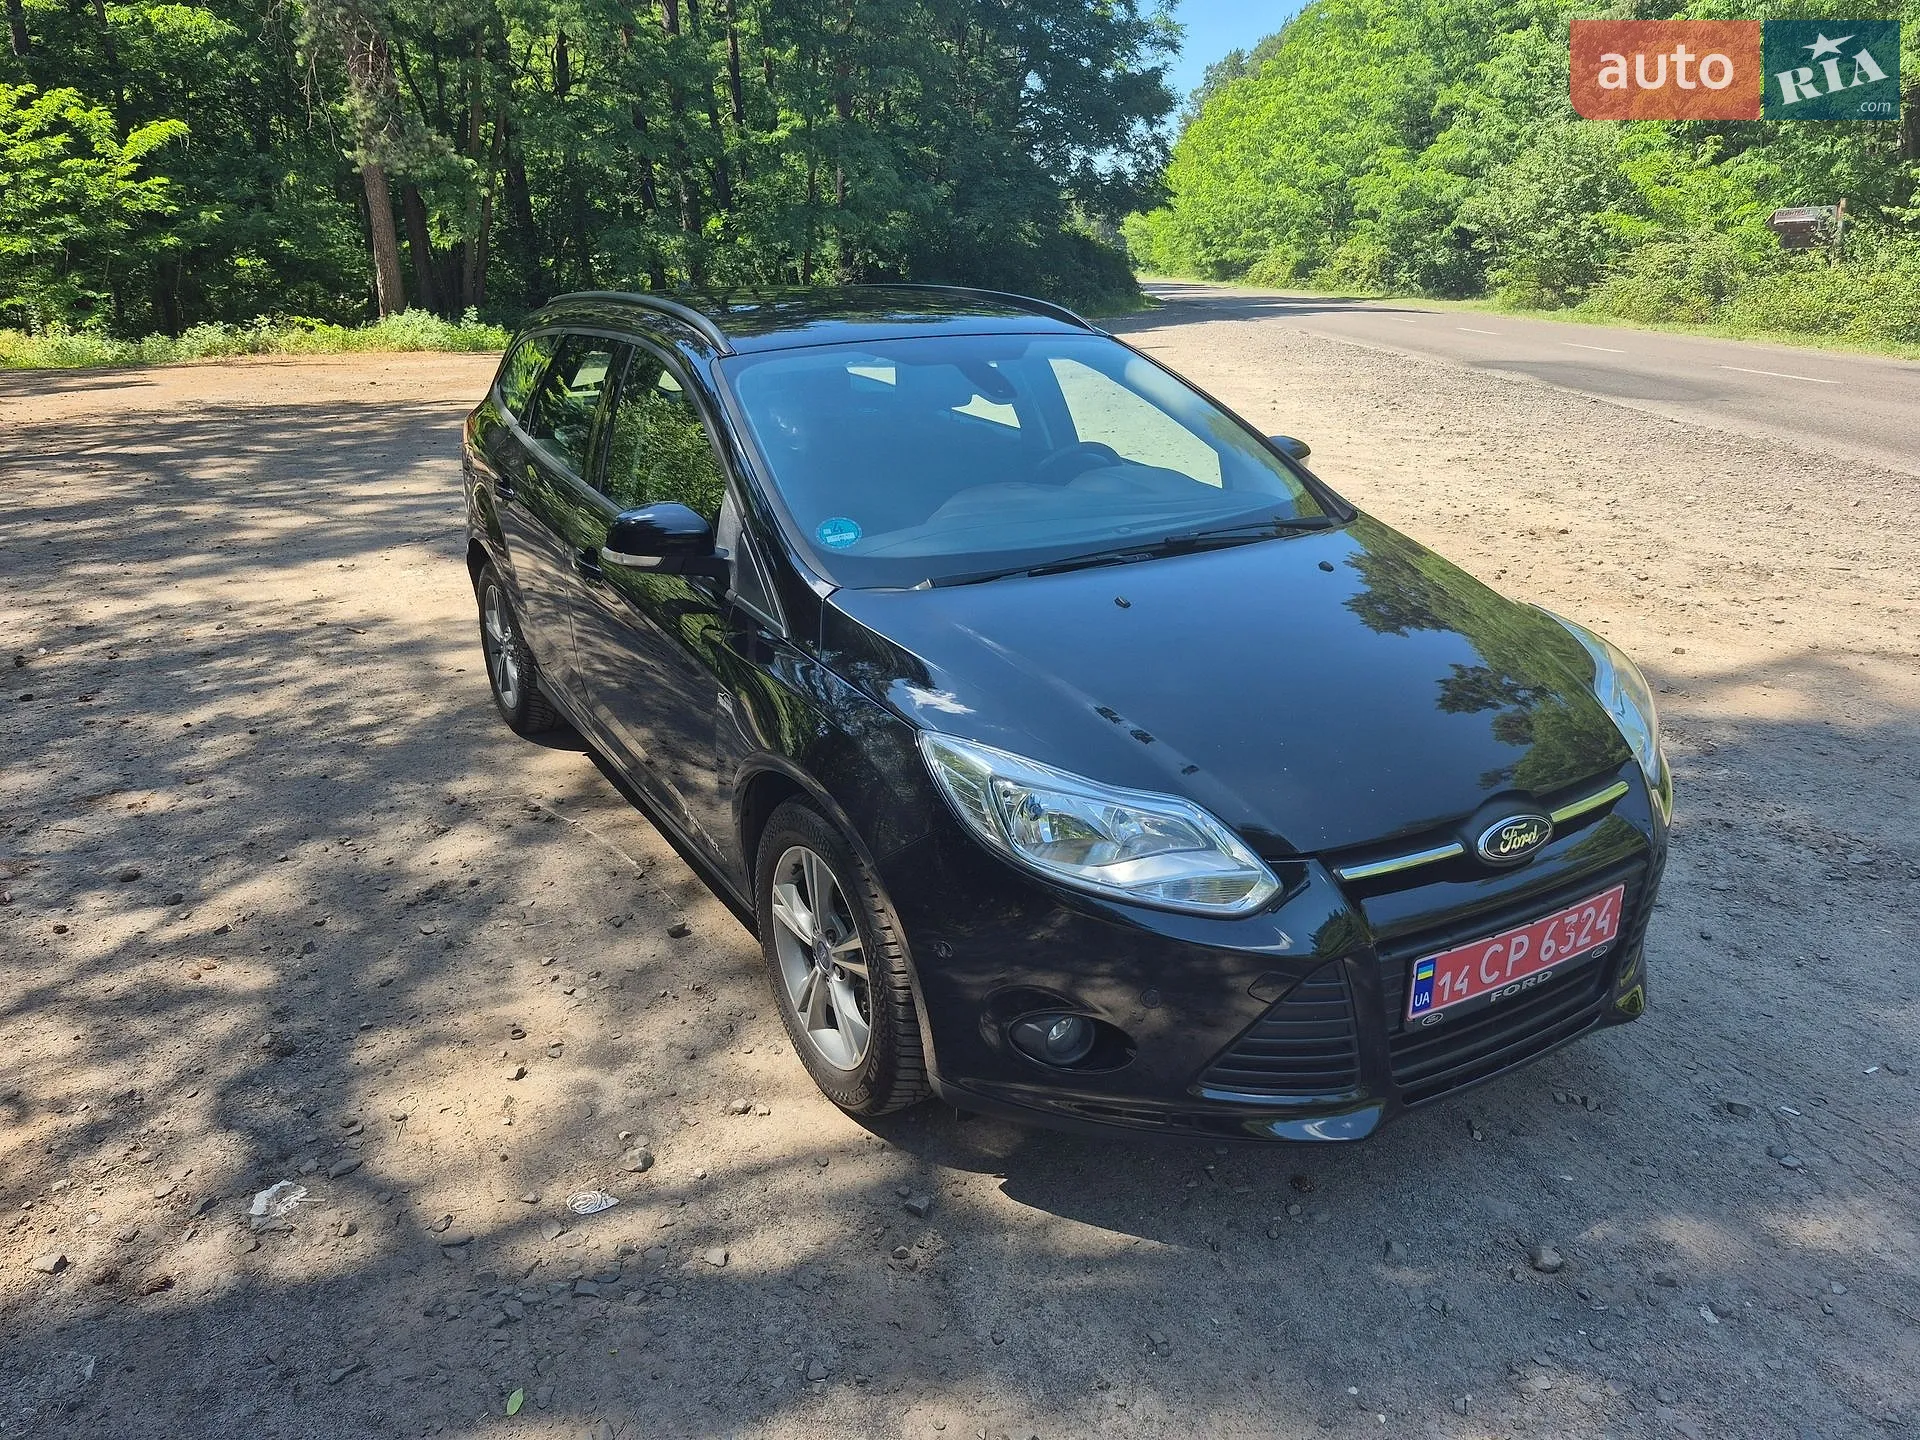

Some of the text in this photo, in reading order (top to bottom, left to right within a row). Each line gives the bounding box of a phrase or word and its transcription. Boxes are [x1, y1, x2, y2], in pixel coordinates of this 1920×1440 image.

[1500, 822, 1538, 854] Ford
[1438, 897, 1613, 1002] 14 CP 6324
[1415, 991, 1430, 1007] UA
[1490, 970, 1553, 1003] FORD
